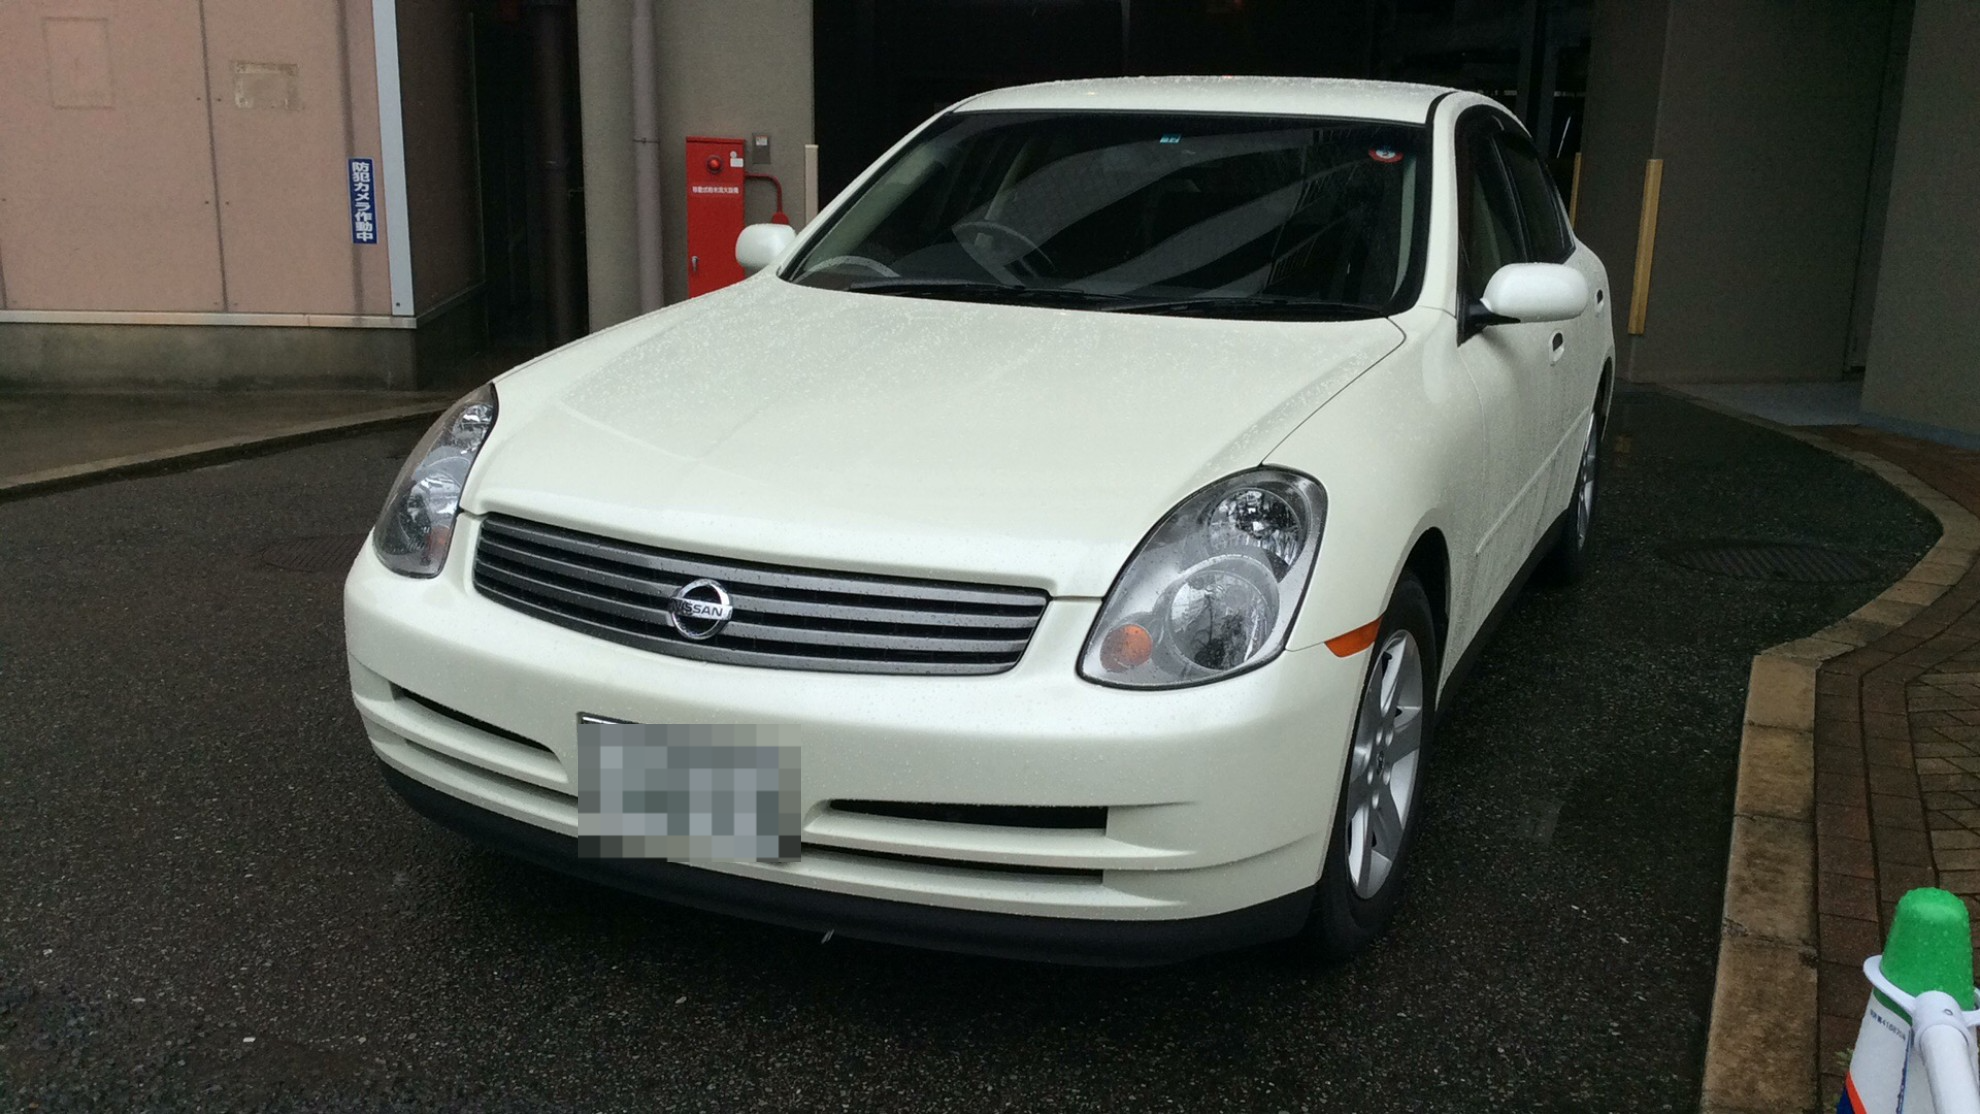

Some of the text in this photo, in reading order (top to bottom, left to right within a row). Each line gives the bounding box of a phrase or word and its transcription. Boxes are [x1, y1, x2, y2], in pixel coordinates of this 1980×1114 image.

[352, 162, 373, 242] 防犯カメラ作動中
[670, 599, 723, 616] NISSAN
